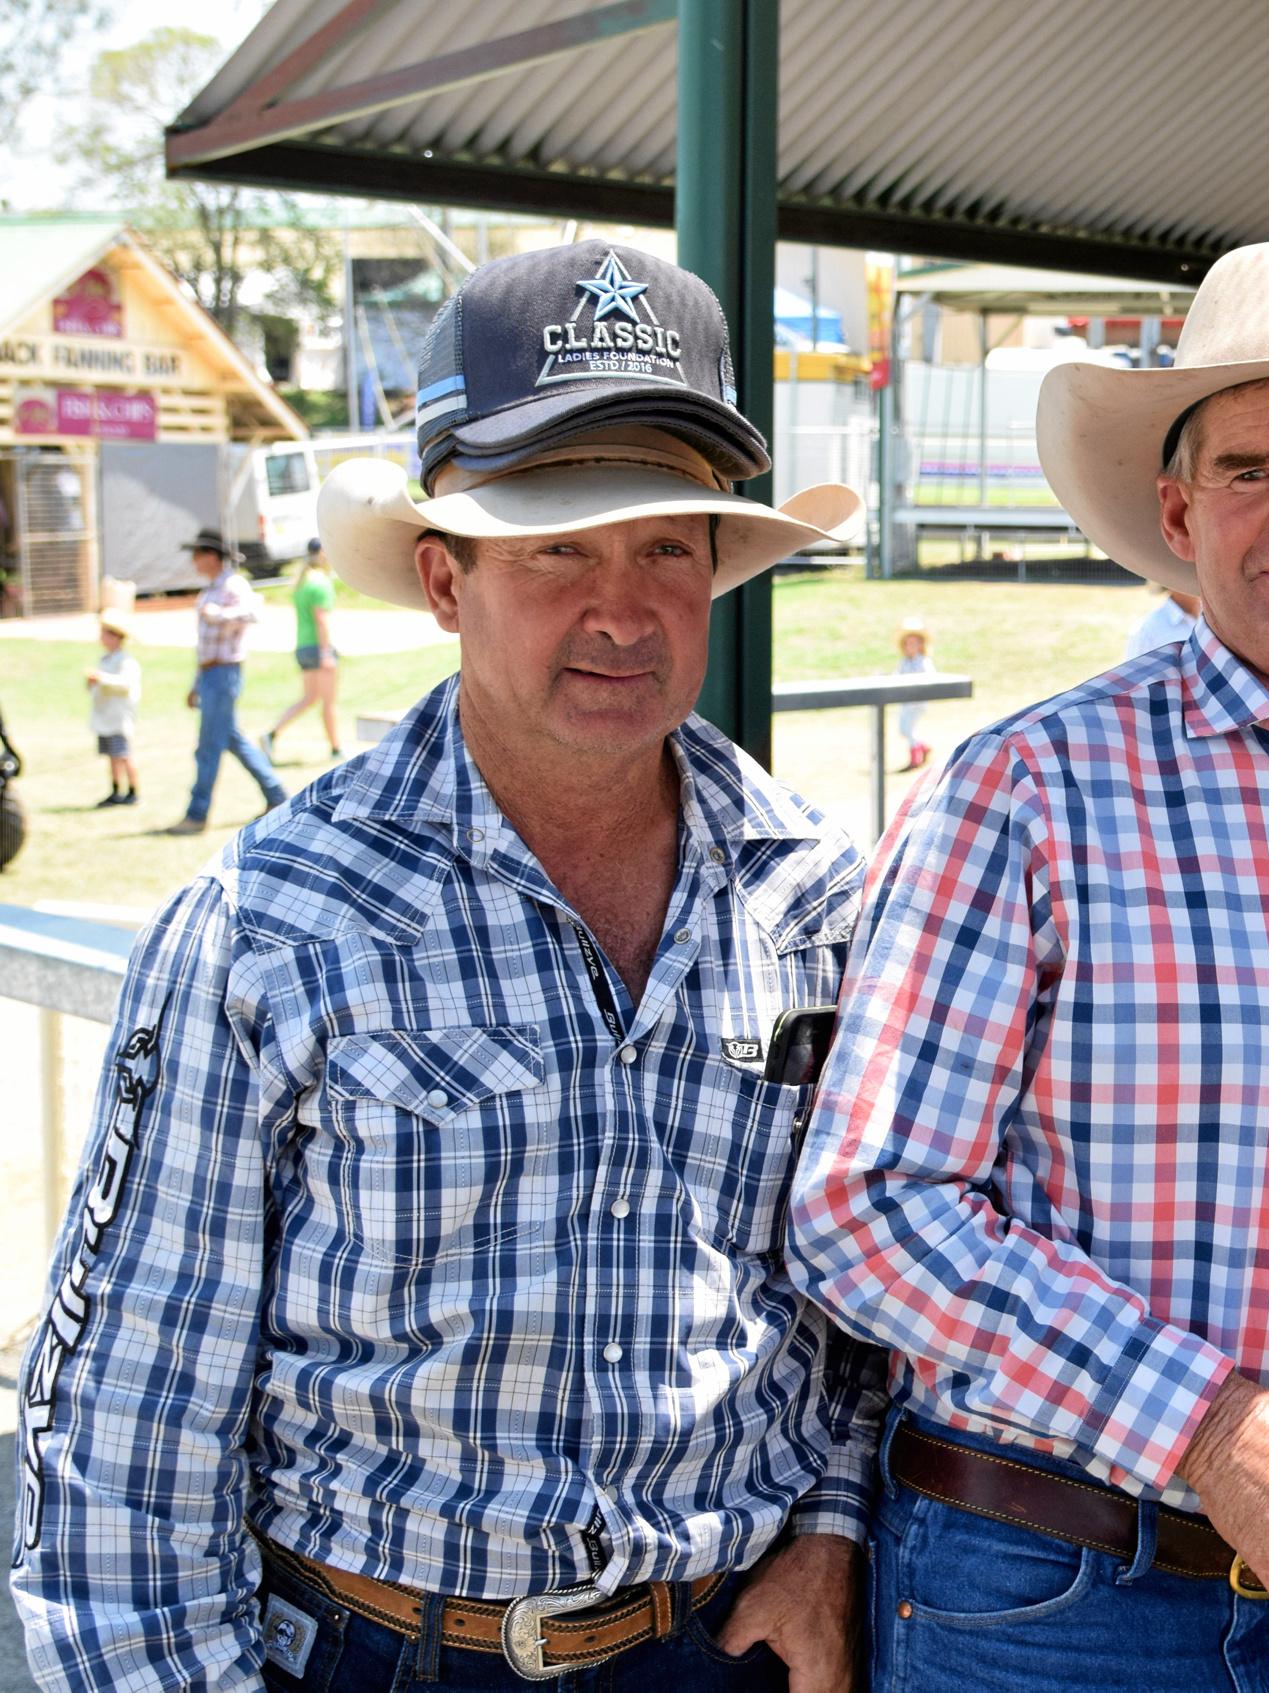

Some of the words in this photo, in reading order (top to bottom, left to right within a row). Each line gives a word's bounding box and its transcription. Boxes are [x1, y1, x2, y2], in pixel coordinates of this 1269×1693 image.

[543, 321, 682, 359] CLASSIC
[557, 350, 600, 364] LADIES
[603, 350, 674, 369] FOUNDATION
[590, 360, 619, 371] ESTD
[627, 361, 653, 373] 2016
